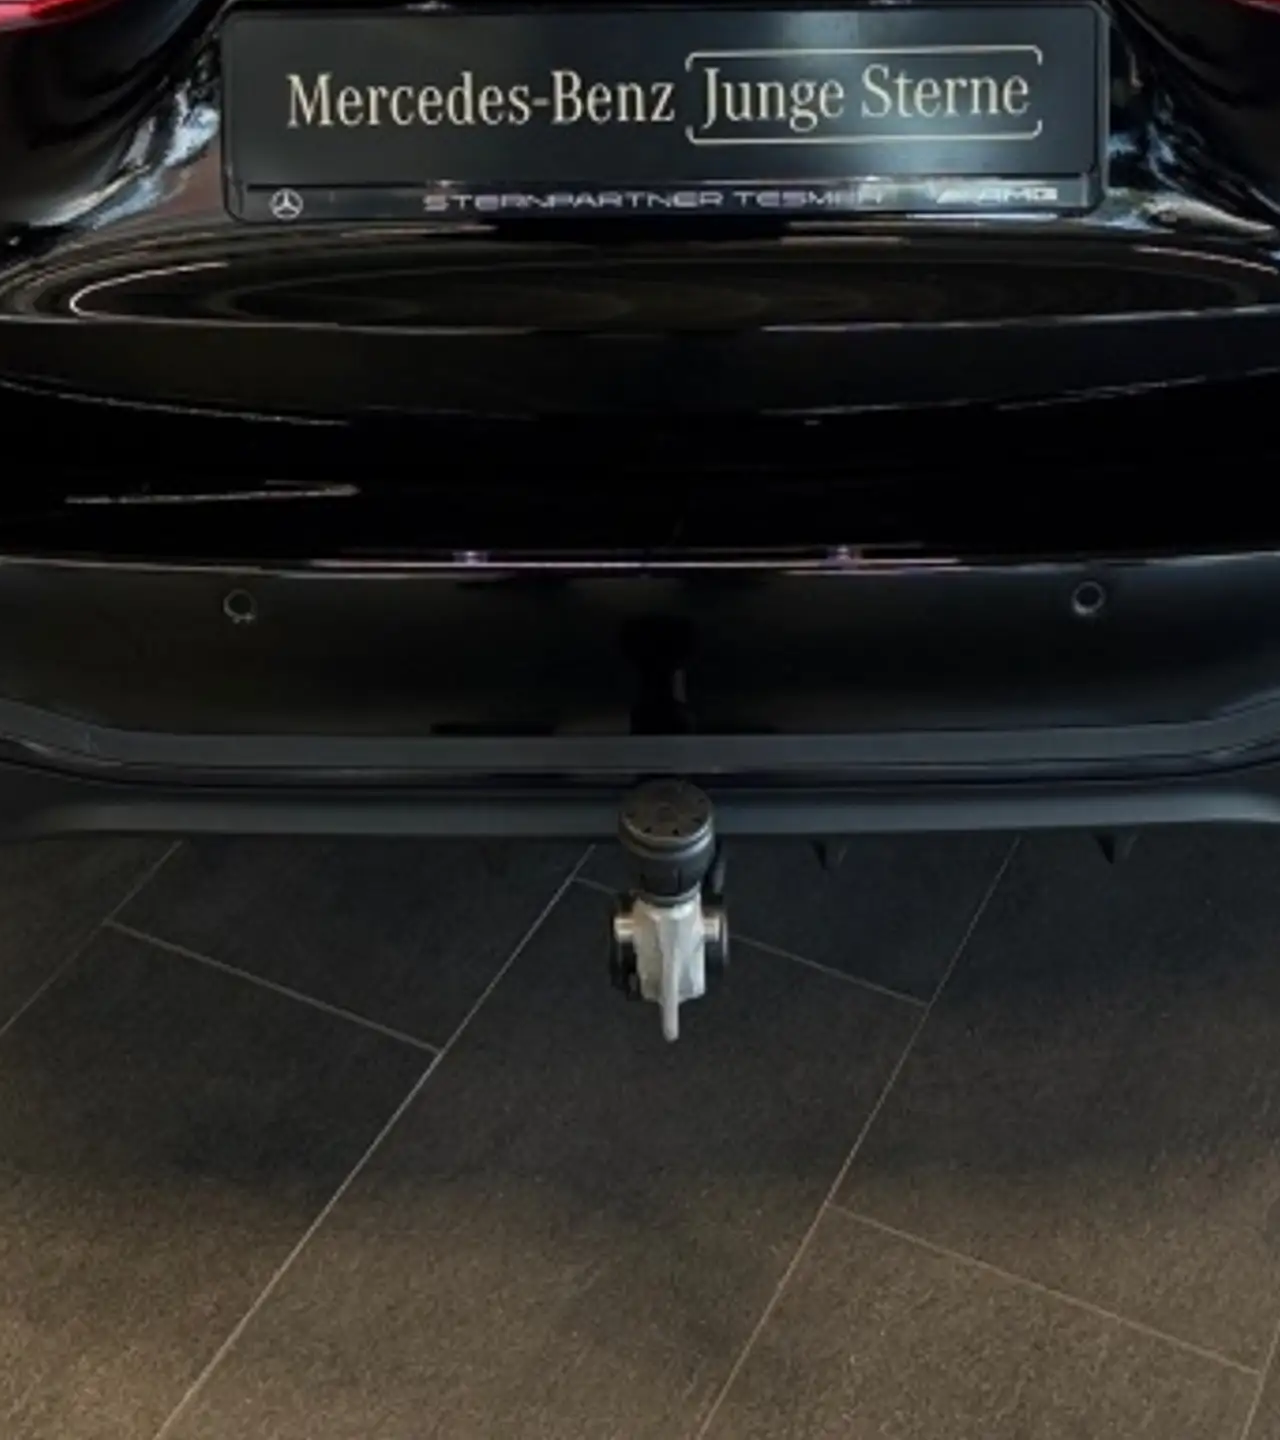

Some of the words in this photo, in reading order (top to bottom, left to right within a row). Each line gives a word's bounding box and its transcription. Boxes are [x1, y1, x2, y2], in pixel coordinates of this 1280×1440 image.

[287, 69, 675, 127] Mercedes-Benz
[701, 67, 845, 133] Junge
[861, 63, 1031, 118] Sterne
[423, 191, 723, 210] STERNPARTNER
